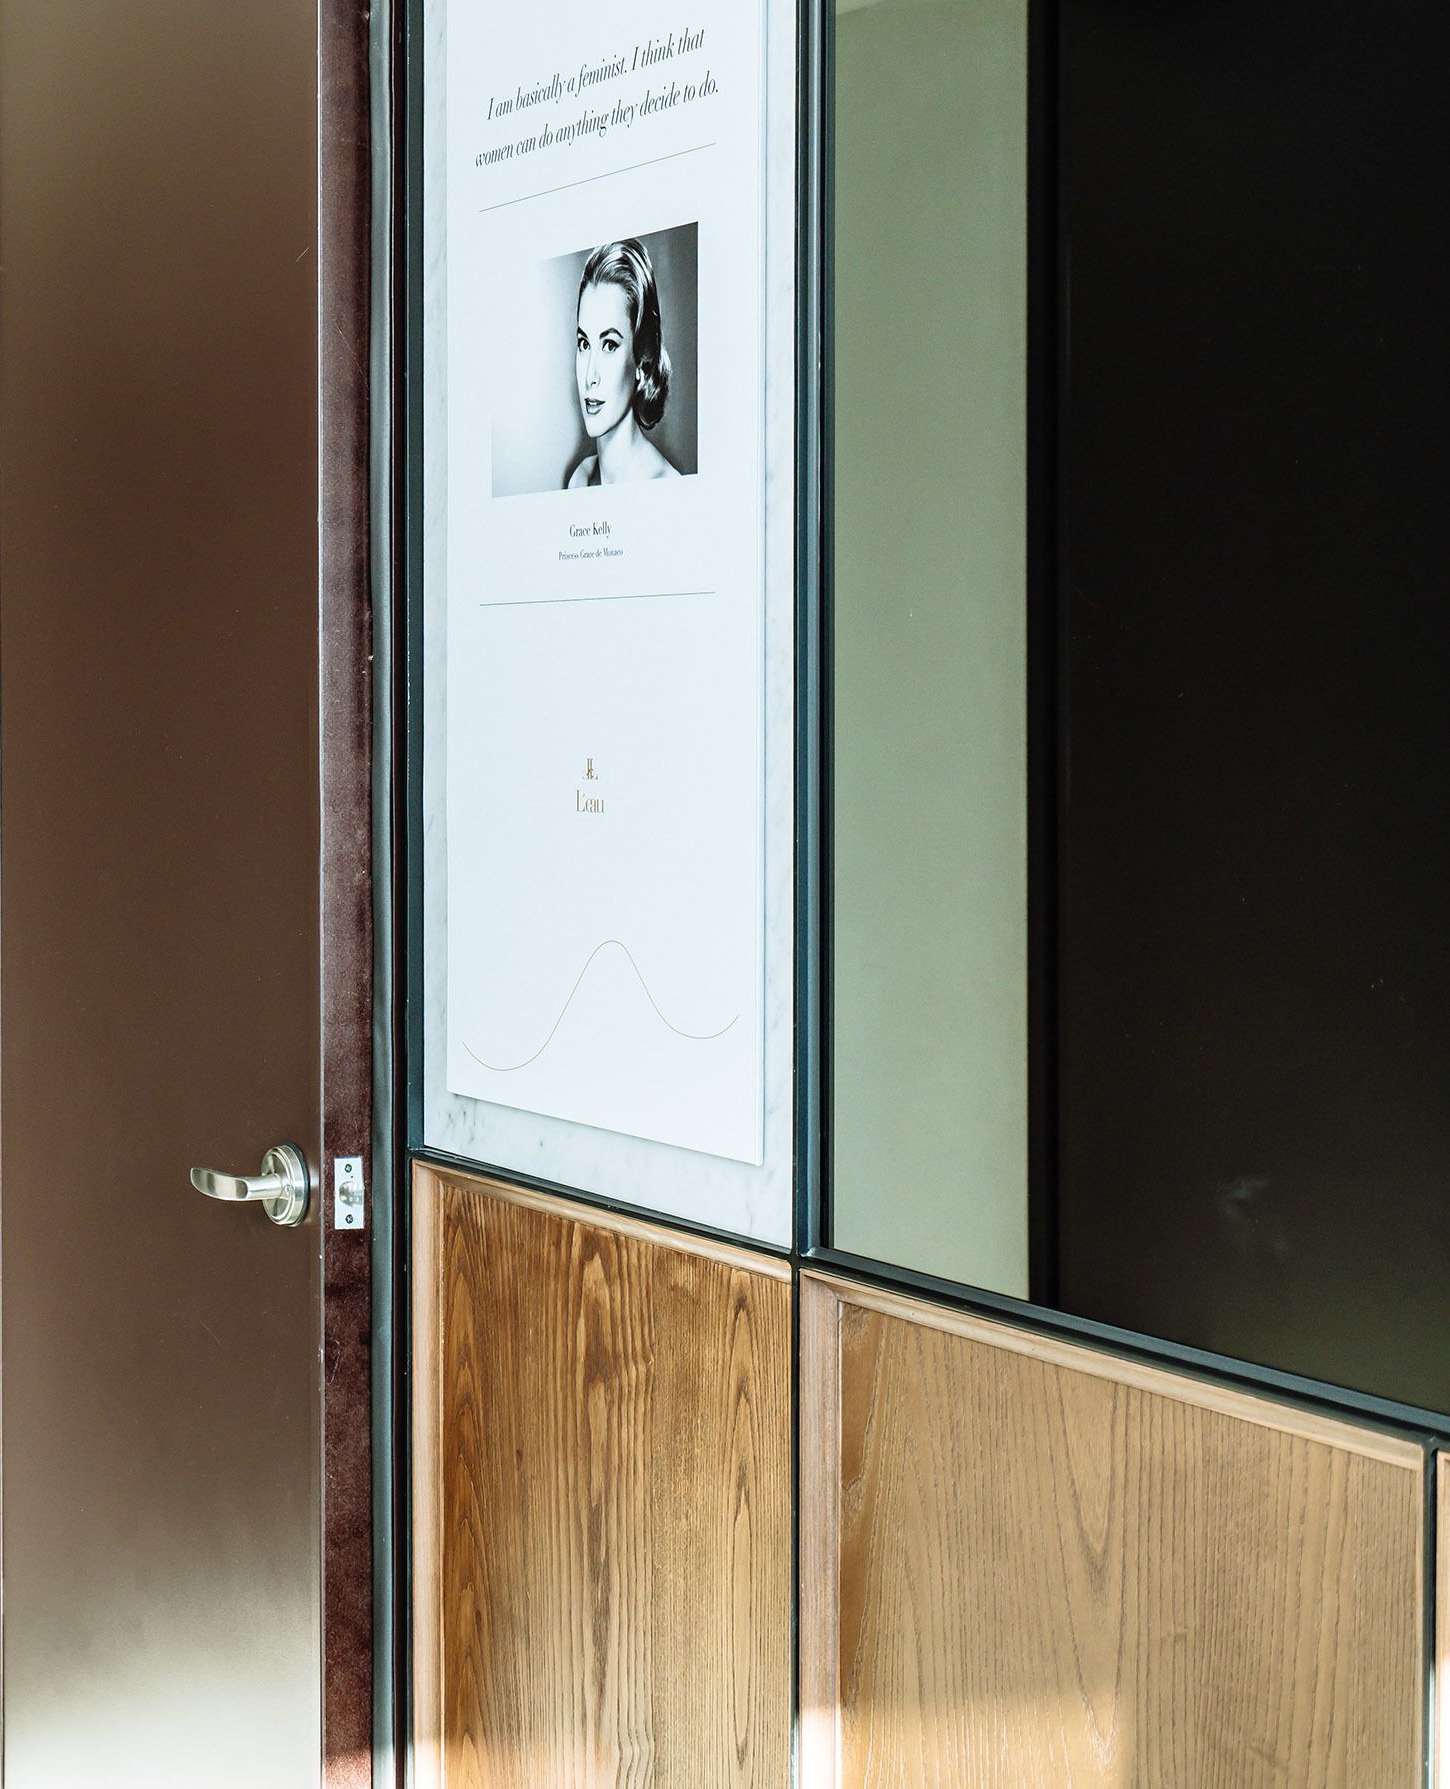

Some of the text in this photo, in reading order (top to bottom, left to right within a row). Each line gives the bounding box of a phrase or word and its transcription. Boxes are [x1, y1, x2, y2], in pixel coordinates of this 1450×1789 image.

[487, 27, 705, 120] I am basically a feminist. I think that
[475, 70, 719, 167] women can do anything they decide to do.
[558, 551, 579, 560] Princess
[580, 549, 594, 559] Grace
[595, 548, 602, 558] de
[569, 521, 611, 539] Grace Kelly
